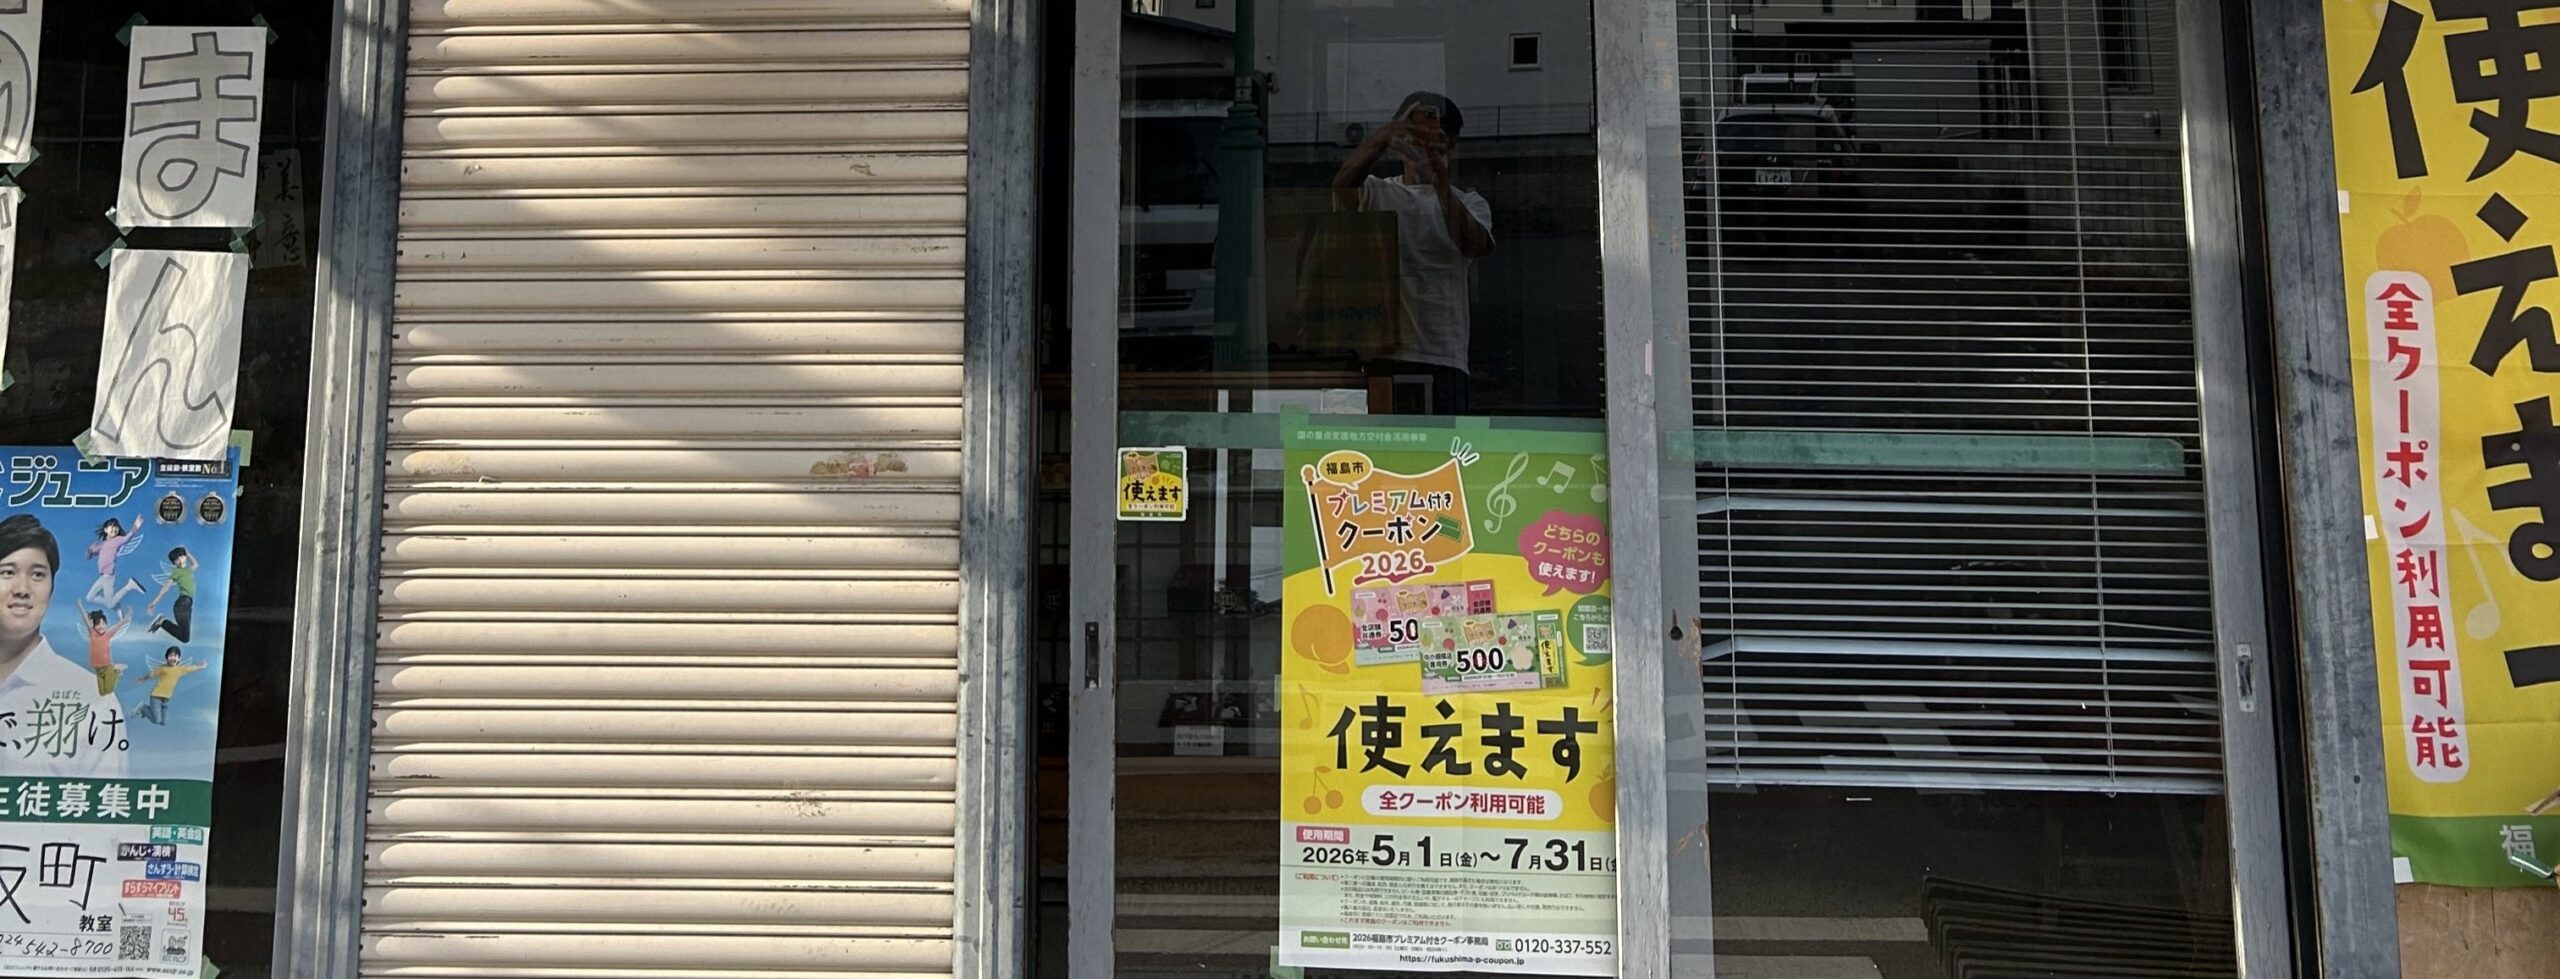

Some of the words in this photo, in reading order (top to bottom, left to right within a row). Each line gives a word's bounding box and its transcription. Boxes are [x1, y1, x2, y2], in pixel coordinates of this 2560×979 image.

[95, 32, 257, 450] まん
[2350, 0, 2560, 689] 使えま
[1326, 461, 1364, 474] 福島市
[0, 455, 151, 508] ジュニア
[1123, 481, 1182, 502] 使えます
[1328, 490, 1452, 516] プレミアム付き
[1338, 516, 1440, 549] クーポン
[1544, 524, 1600, 546] どちらの
[2375, 283, 2463, 769] 全クーポン利用可能
[1362, 551, 1424, 575] 2026
[1532, 541, 1606, 566] クーポンも
[1456, 647, 1505, 673] 500
[1327, 695, 1598, 784] 使えます
[0, 781, 170, 820] 徒募集中
[1379, 791, 1545, 814] 全クーポン利用可能
[1303, 829, 1344, 842] 使用期間
[80, 915, 113, 932] 教室
[1400, 954, 1525, 965] https://fukushima-p-coupon.jp
[1515, 939, 1612, 955] 0120-337-552
